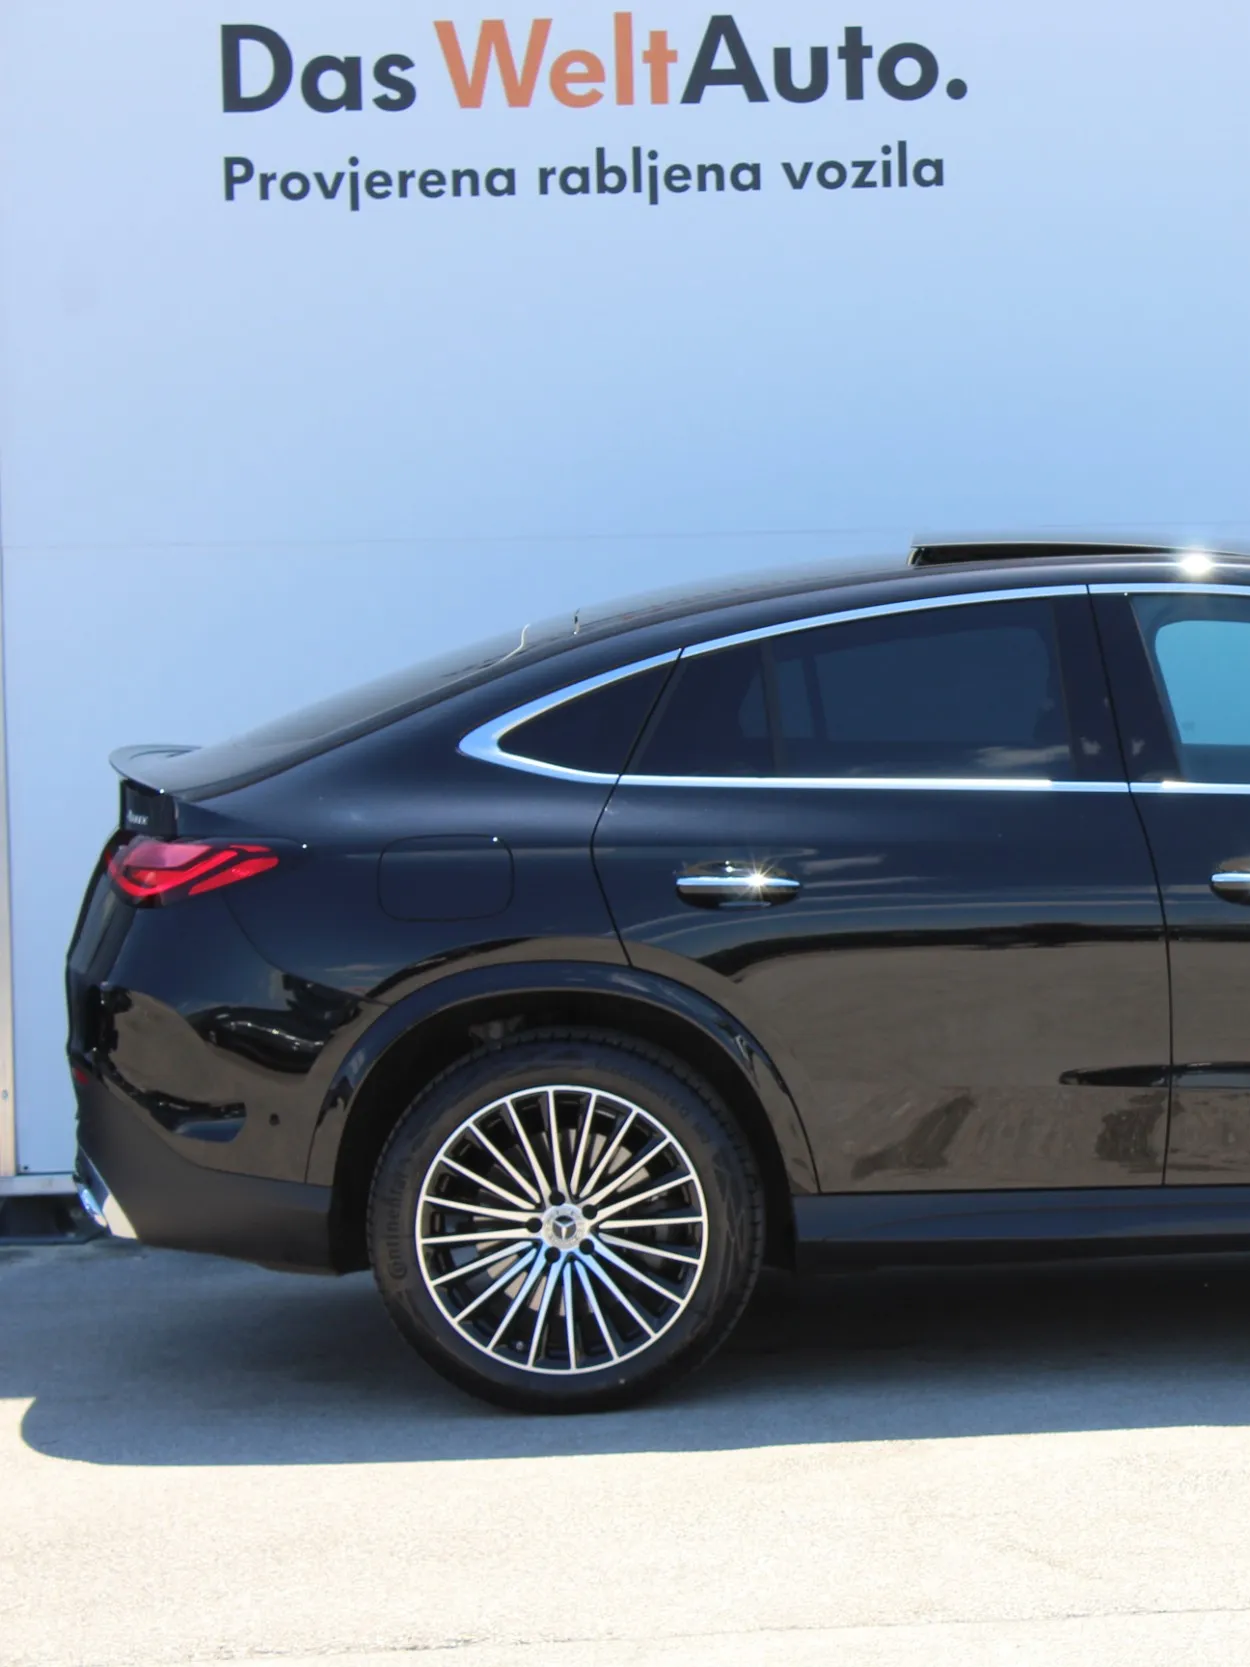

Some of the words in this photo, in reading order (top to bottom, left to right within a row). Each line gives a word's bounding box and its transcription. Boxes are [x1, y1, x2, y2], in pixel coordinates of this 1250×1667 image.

[220, 24, 417, 114] Das
[433, 12, 968, 108] WeltAuto.
[223, 156, 516, 212] Provjerena
[538, 146, 762, 206] rabljena
[780, 140, 944, 191] vozila
